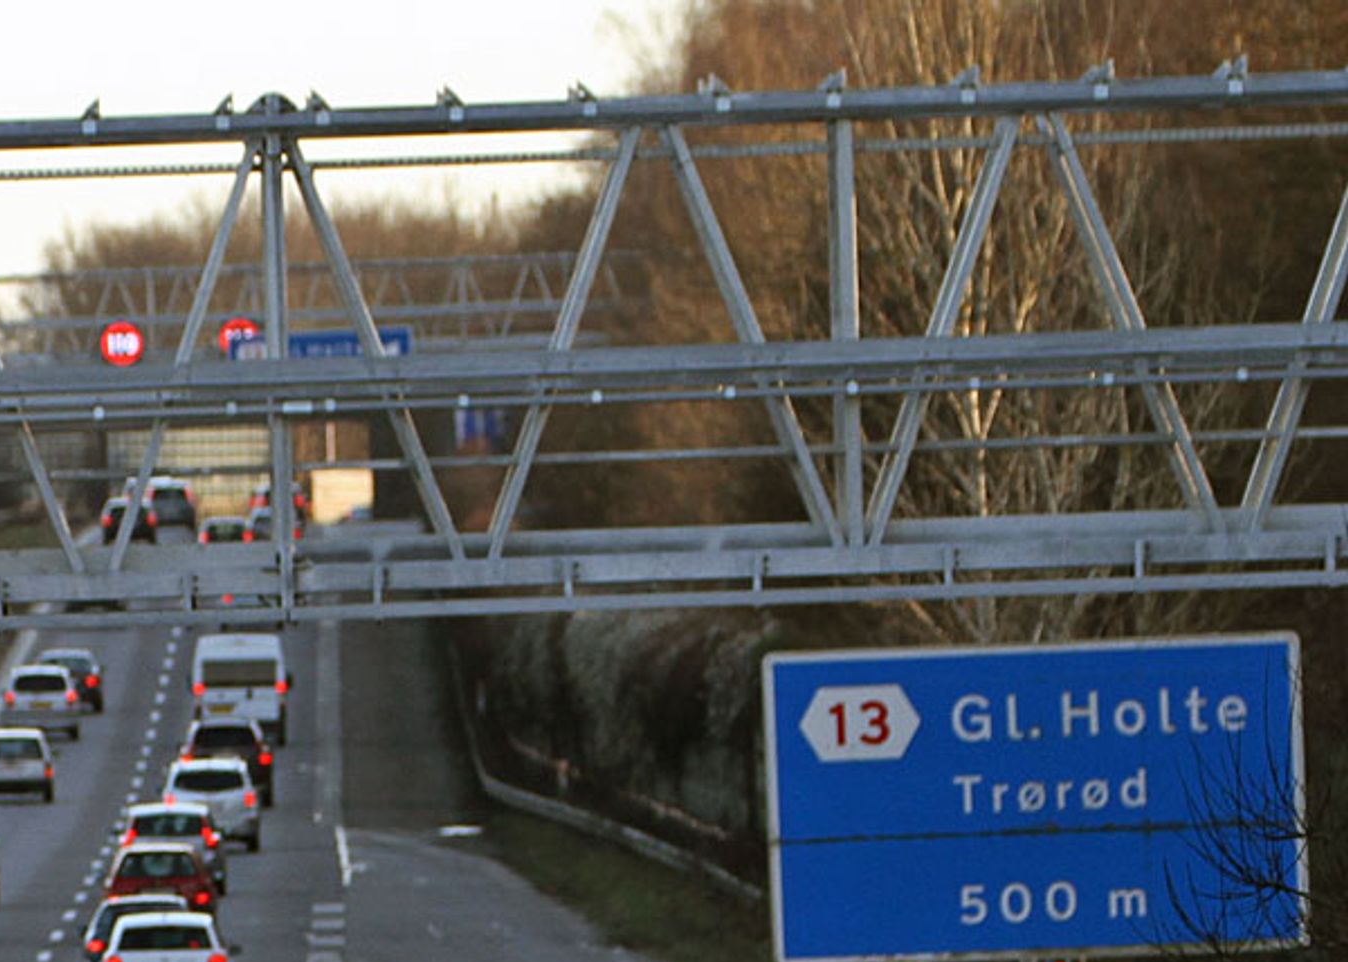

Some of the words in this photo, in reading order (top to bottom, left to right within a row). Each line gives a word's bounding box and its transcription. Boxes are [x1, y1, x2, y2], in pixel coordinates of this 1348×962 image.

[830, 702, 890, 744] 13
[954, 769, 1147, 813] Trørød
[961, 881, 1077, 923] 500
[1109, 888, 1147, 918] m
